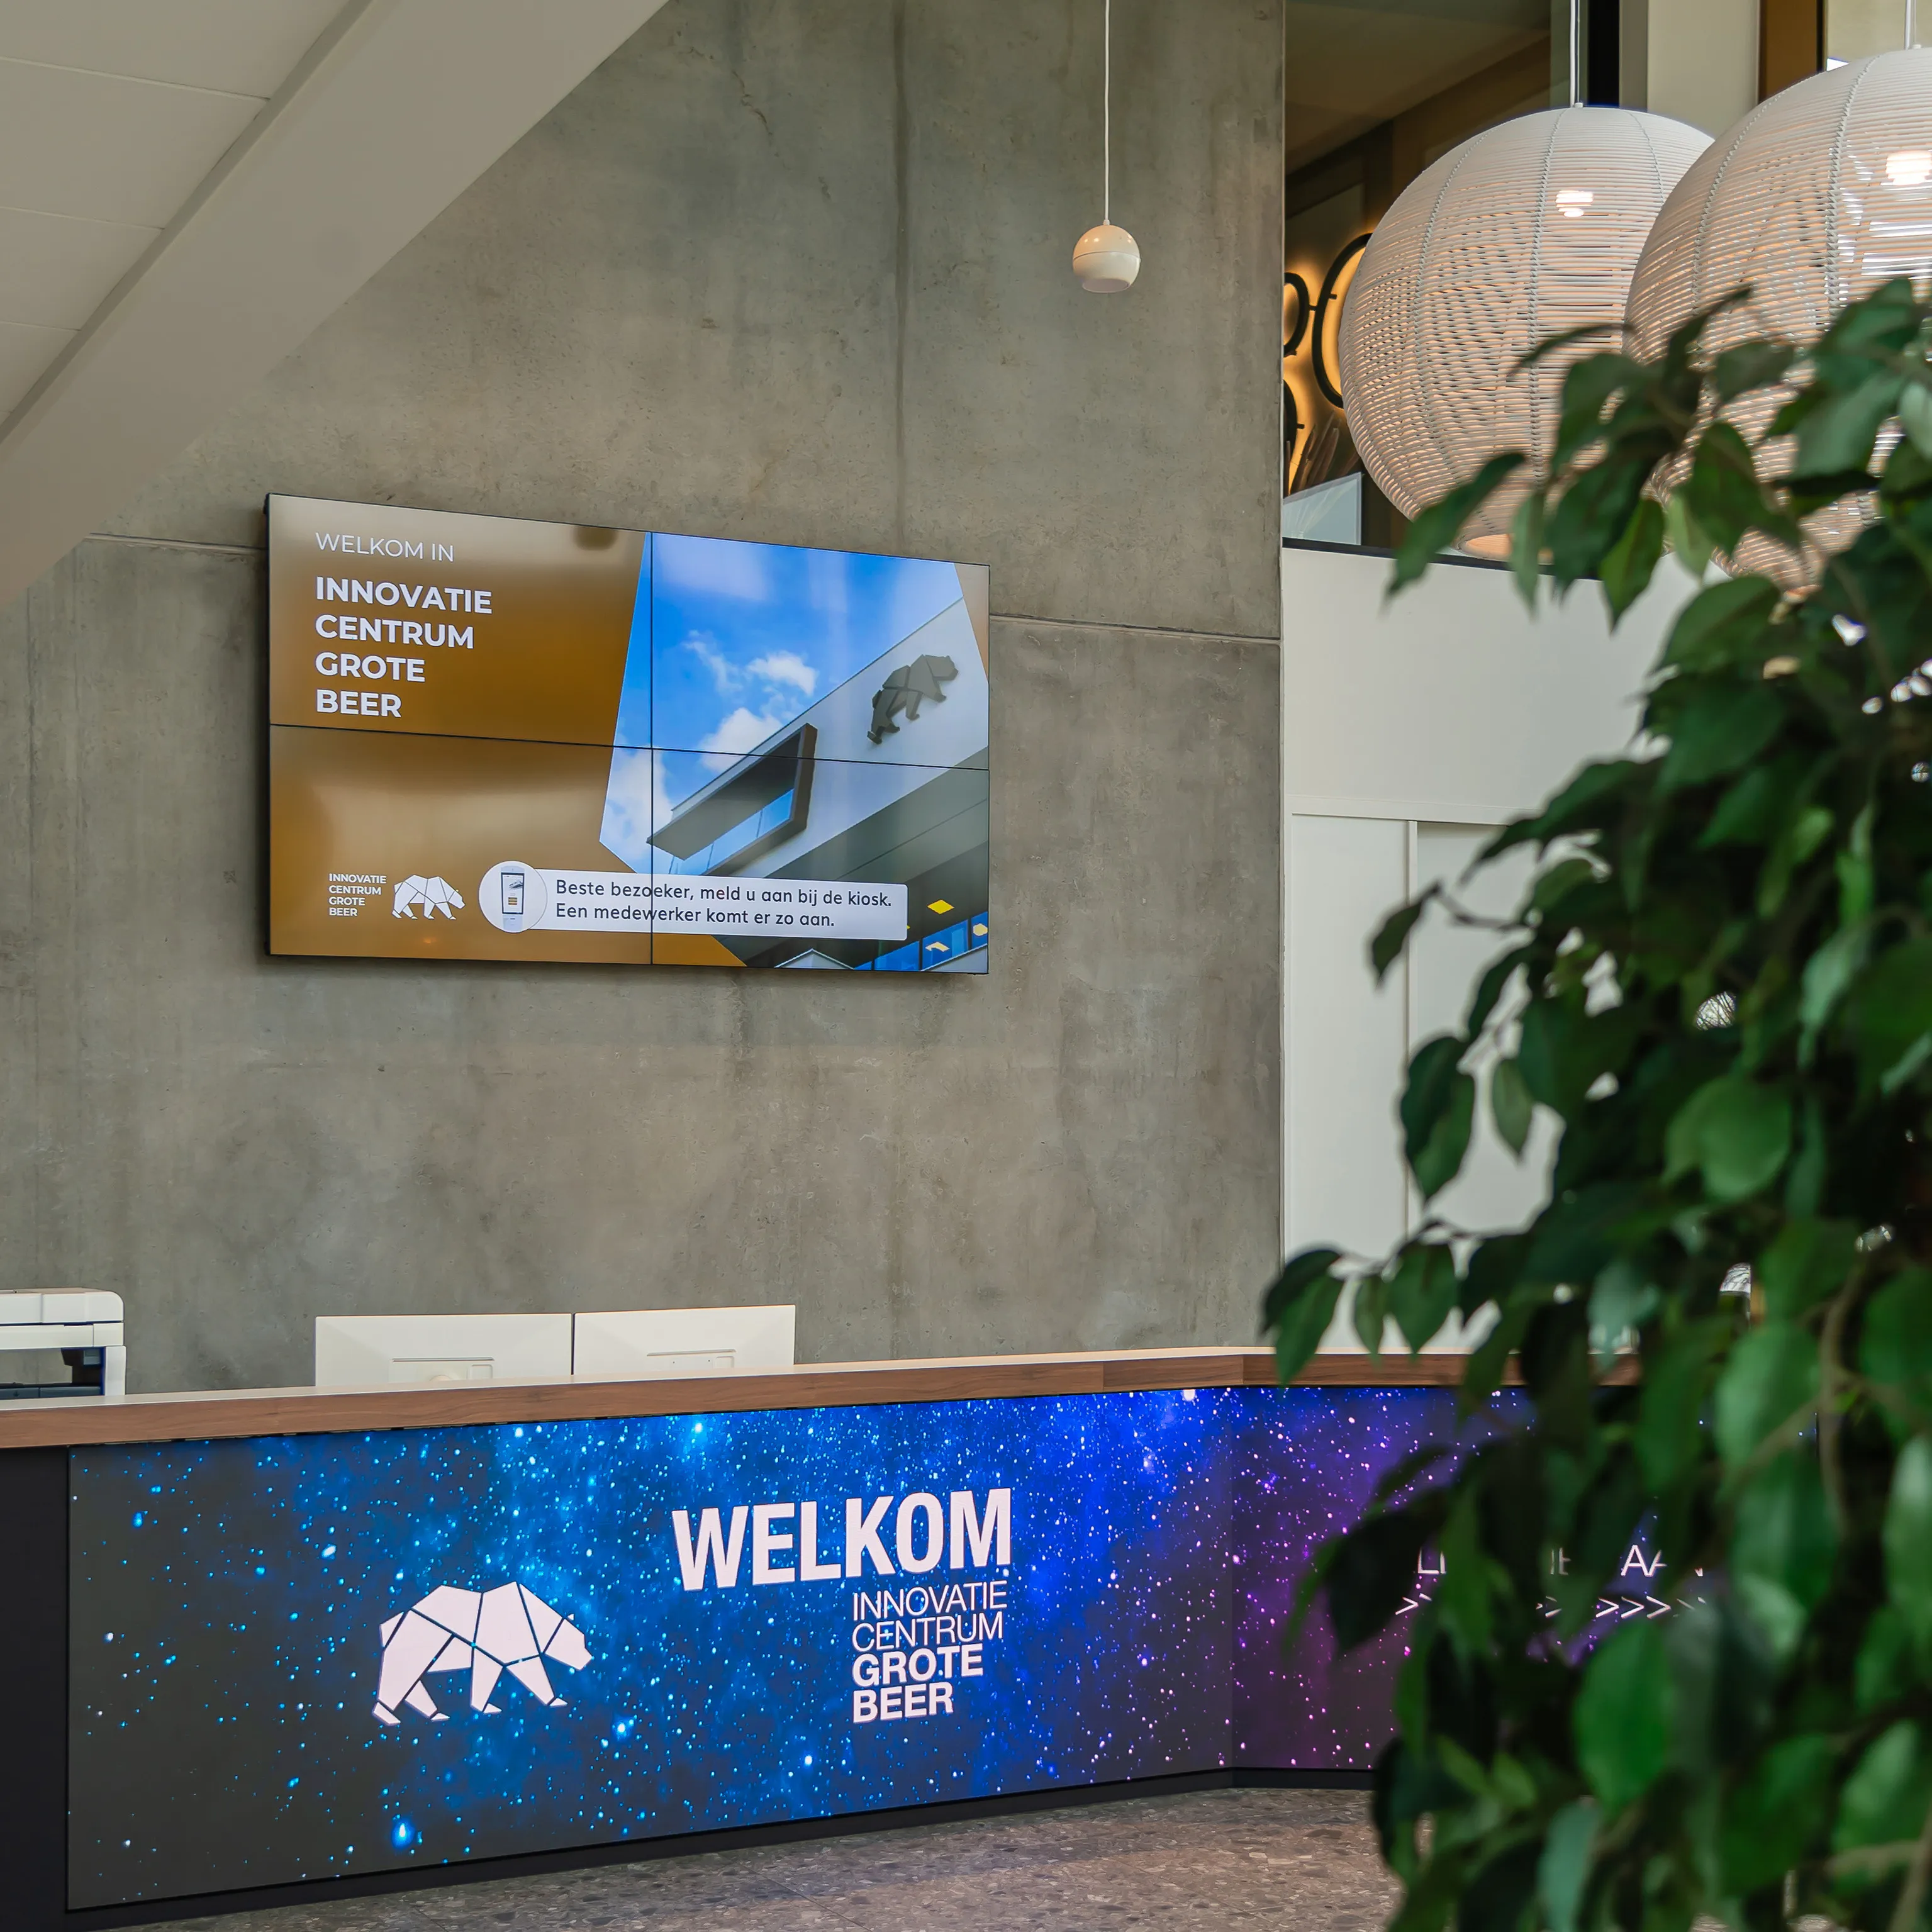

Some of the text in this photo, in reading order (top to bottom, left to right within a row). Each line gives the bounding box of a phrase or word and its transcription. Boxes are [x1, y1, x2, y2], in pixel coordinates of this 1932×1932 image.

[315, 532, 454, 562] WELKOM IN
[316, 576, 493, 615] INNOVATIE
[315, 614, 474, 649] CENTRUM
[315, 651, 425, 683] GROTE
[316, 688, 402, 718] BEER
[328, 873, 387, 884] INNOVATIE
[328, 885, 382, 895] CENTRUM
[556, 879, 891, 907] Beste bezoeker, meld u aan bij de kiosk.
[328, 896, 366, 906] GROTE
[329, 907, 358, 917] BEER
[556, 903, 835, 927] Een medewerker komt er zo aan.
[672, 1488, 1011, 1591] WELKOM
[853, 1580, 1007, 1621] INNOVATIE
[852, 1612, 1003, 1652] CENTRUM
[852, 1644, 983, 1687] GROTE
[853, 1682, 954, 1723] BEER
